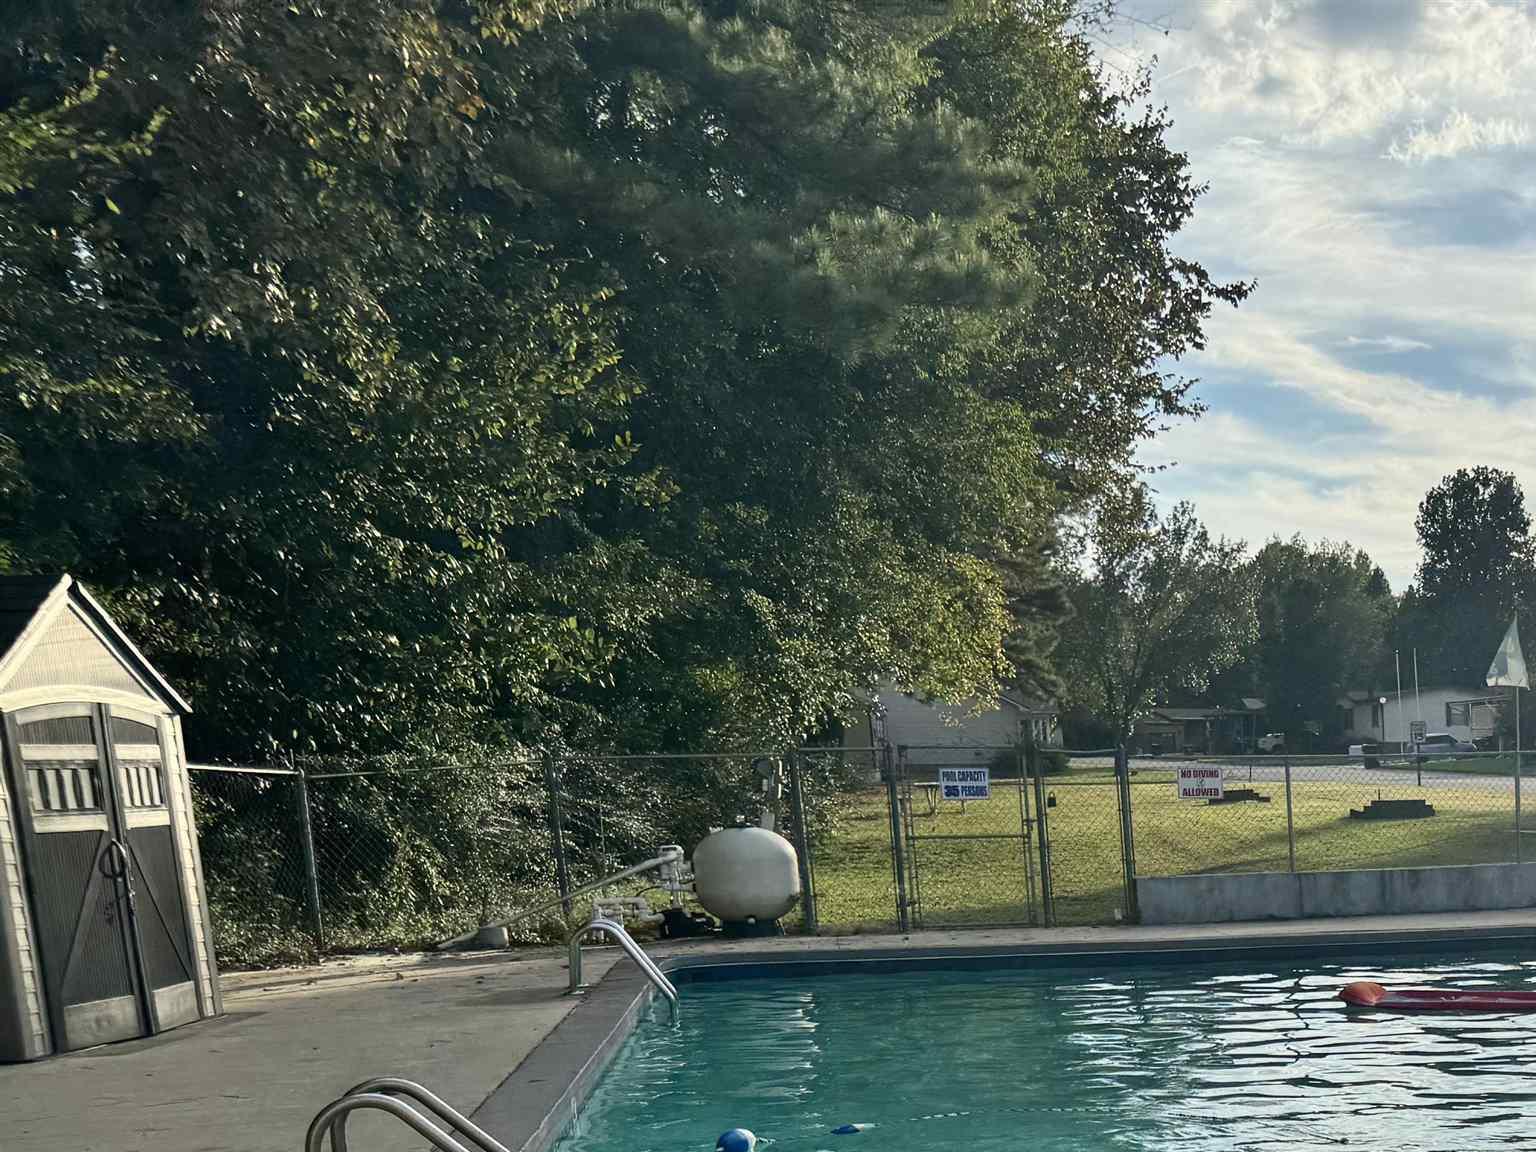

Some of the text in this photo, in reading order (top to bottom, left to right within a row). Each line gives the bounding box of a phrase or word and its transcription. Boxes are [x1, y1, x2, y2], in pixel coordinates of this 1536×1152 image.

[958, 771, 986, 781] CAPACITY
[1181, 769, 1219, 779] NO DIVING
[961, 785, 988, 797] PERSONS
[1183, 787, 1219, 797] ALLOWED
